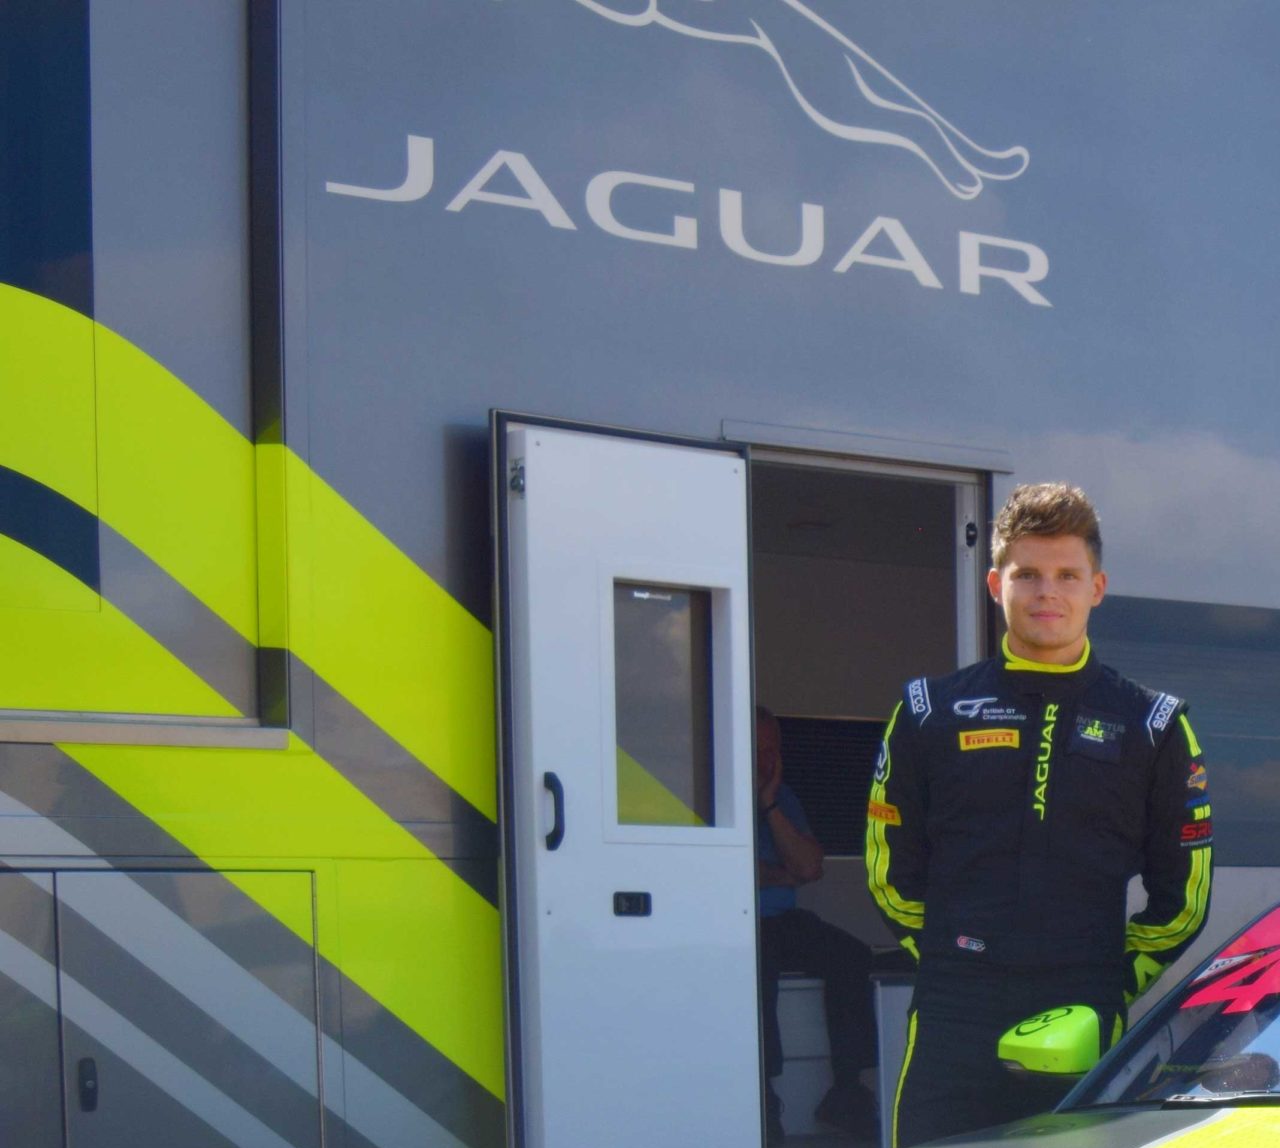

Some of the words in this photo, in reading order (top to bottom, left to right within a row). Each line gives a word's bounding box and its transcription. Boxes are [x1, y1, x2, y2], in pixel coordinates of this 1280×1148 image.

[325, 133, 1054, 308] JAGUAR
[964, 731, 1014, 746] PIRELLI
[1033, 703, 1059, 821] JAGUAR
